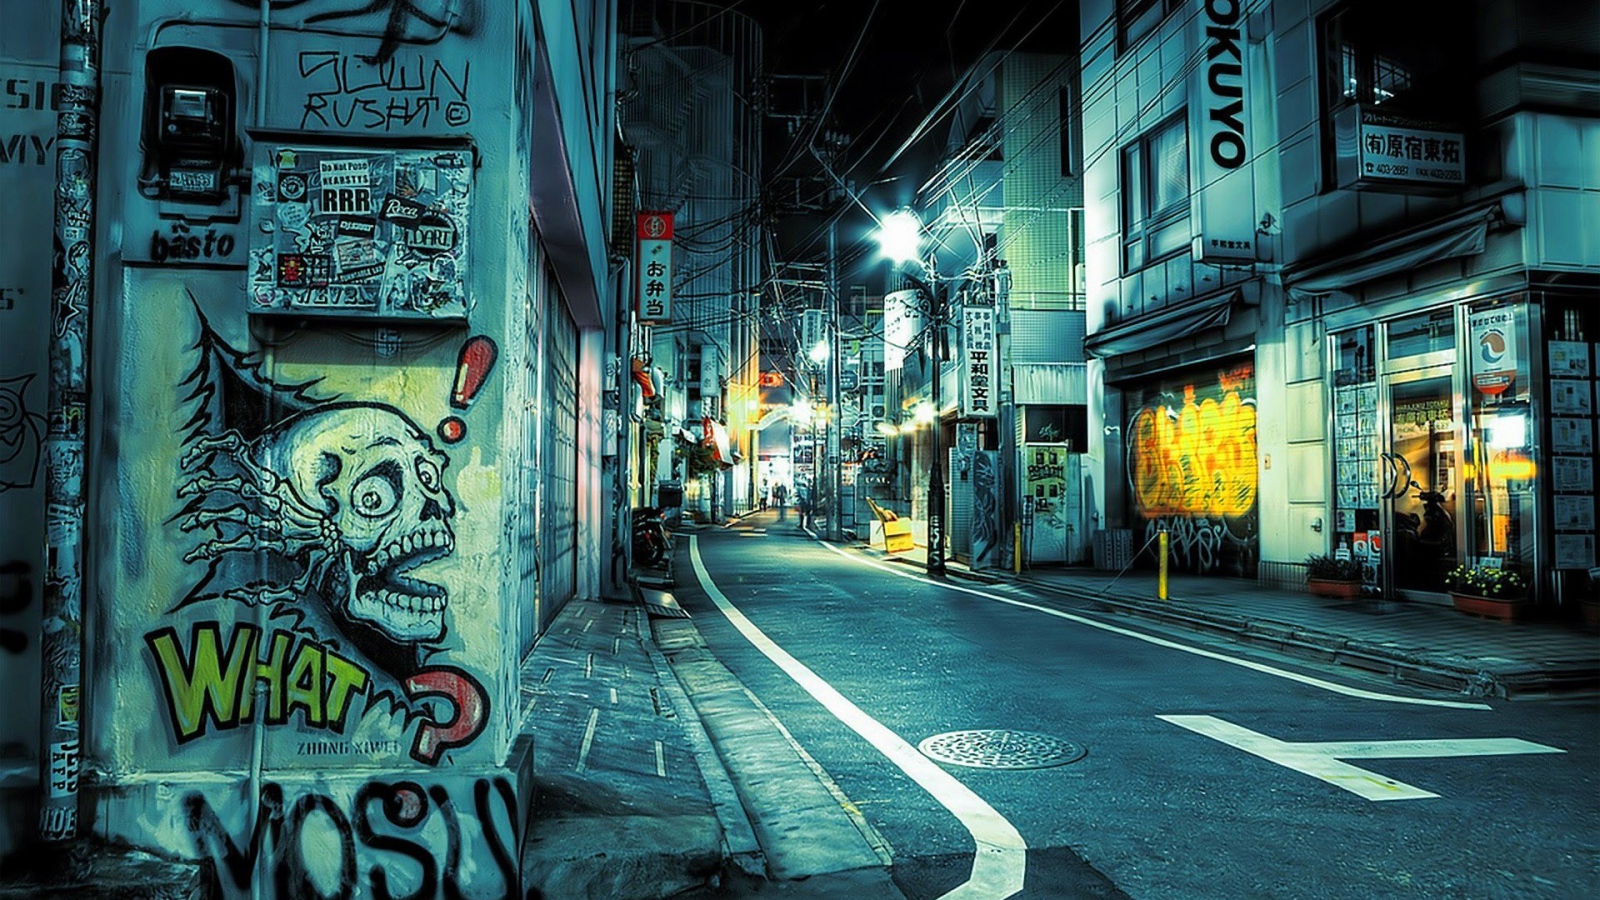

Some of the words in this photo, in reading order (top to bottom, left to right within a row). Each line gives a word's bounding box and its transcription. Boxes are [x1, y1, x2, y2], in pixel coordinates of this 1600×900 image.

[323, 188, 370, 213] RRR
[645, 260, 667, 316] お弁当
[144, 621, 371, 745] WHAT
